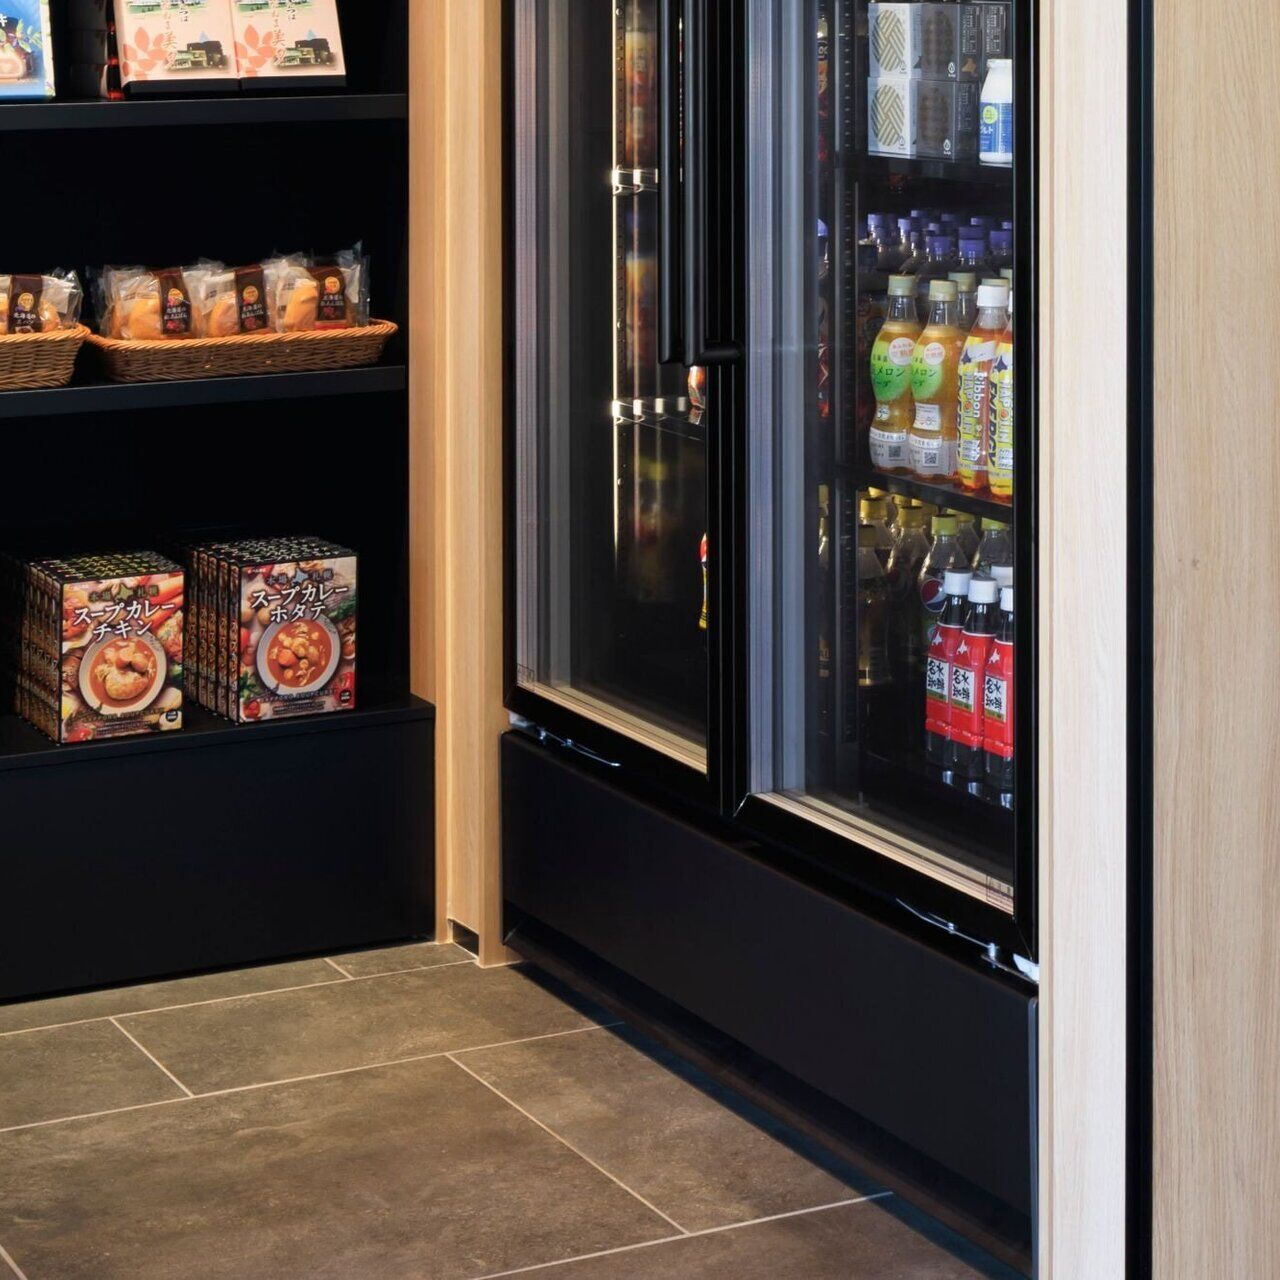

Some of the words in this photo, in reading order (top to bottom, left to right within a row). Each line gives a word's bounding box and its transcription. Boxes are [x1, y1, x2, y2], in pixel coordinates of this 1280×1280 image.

[973, 371, 988, 418] Ribbon
[988, 379, 998, 467] ENERGY
[251, 583, 349, 609] スープカレー
[73, 600, 176, 626] スープカレー
[270, 602, 326, 623] ホタテ
[92, 620, 153, 642] チキン
